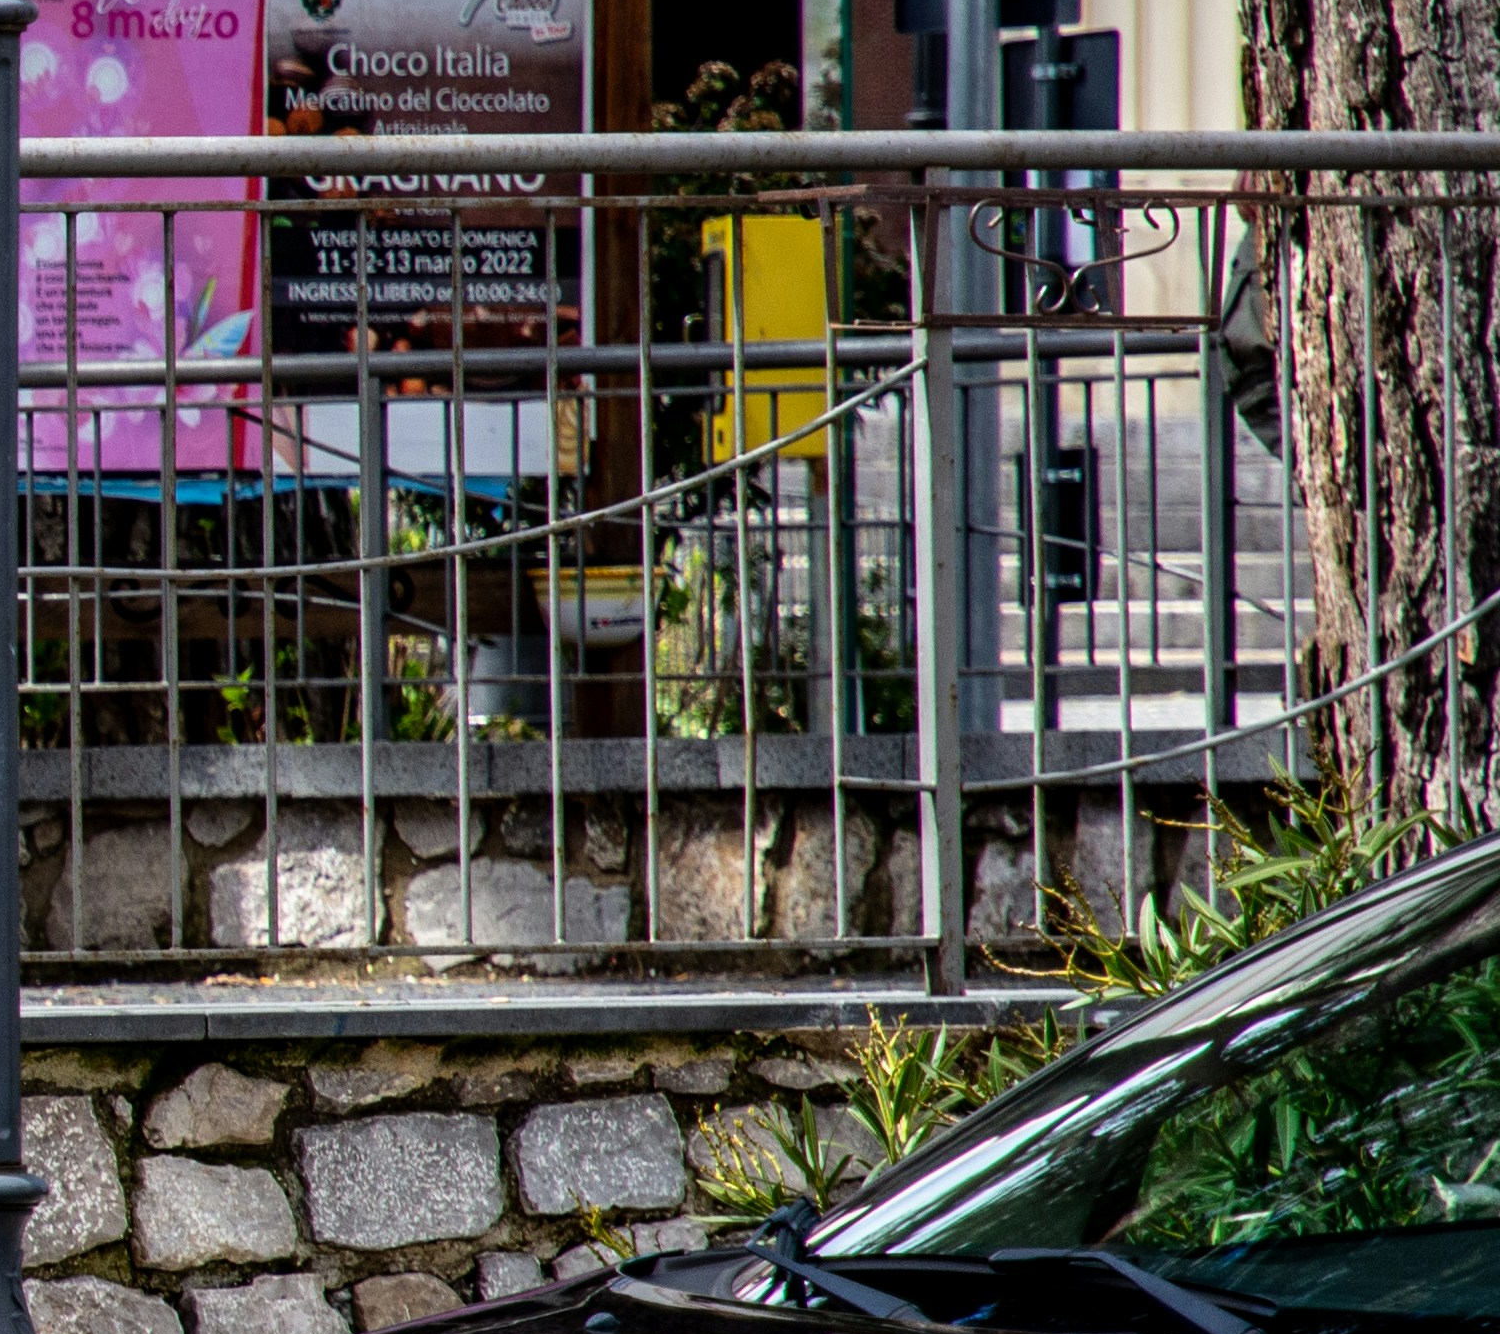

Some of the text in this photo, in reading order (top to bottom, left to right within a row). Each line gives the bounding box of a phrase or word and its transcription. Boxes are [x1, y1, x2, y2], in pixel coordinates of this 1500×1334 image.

[72, 0, 239, 39] 8 marzo
[326, 42, 510, 77] Choco Italia
[284, 86, 551, 113] Mercatino del Cioccolato
[414, 254, 477, 274] maro
[480, 249, 533, 274] 2022
[375, 281, 435, 302] LIBERO
